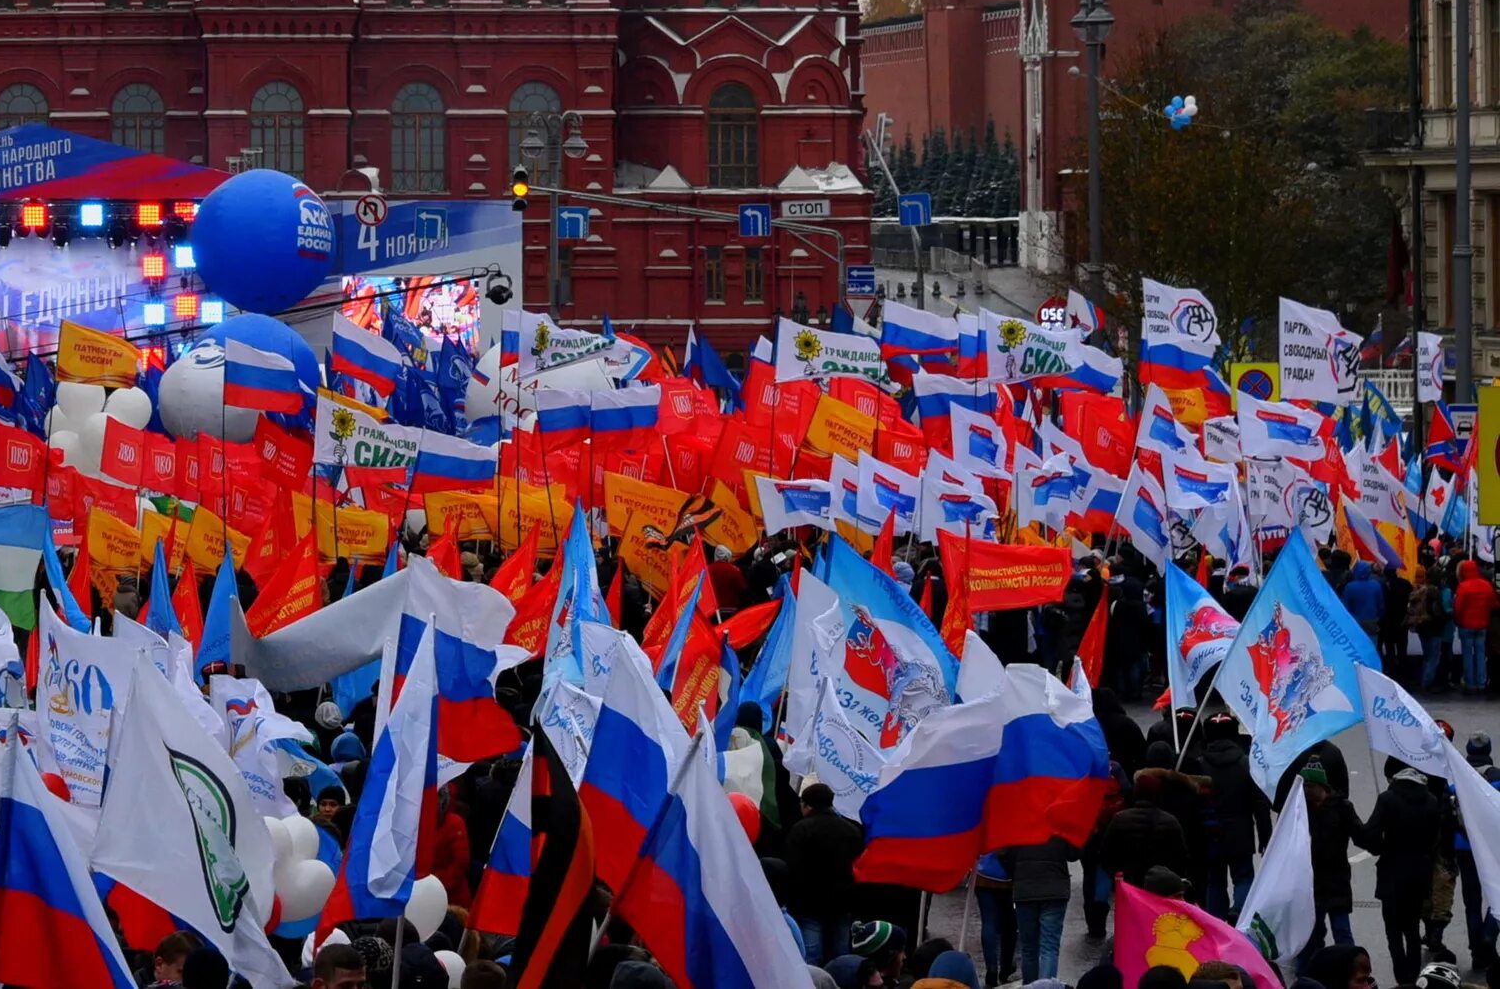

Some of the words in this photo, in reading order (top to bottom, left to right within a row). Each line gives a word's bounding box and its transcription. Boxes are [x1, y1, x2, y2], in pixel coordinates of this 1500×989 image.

[2, 138, 72, 165] НАРОДНОГО
[787, 200, 825, 216] СТОП
[357, 221, 380, 261] 4
[21, 273, 127, 327] ЕДИНЫ!
[74, 342, 124, 359] ПАТРИОТЫ
[79, 354, 113, 366] РОССИИ
[1032, 575, 1063, 587] РОССИИ
